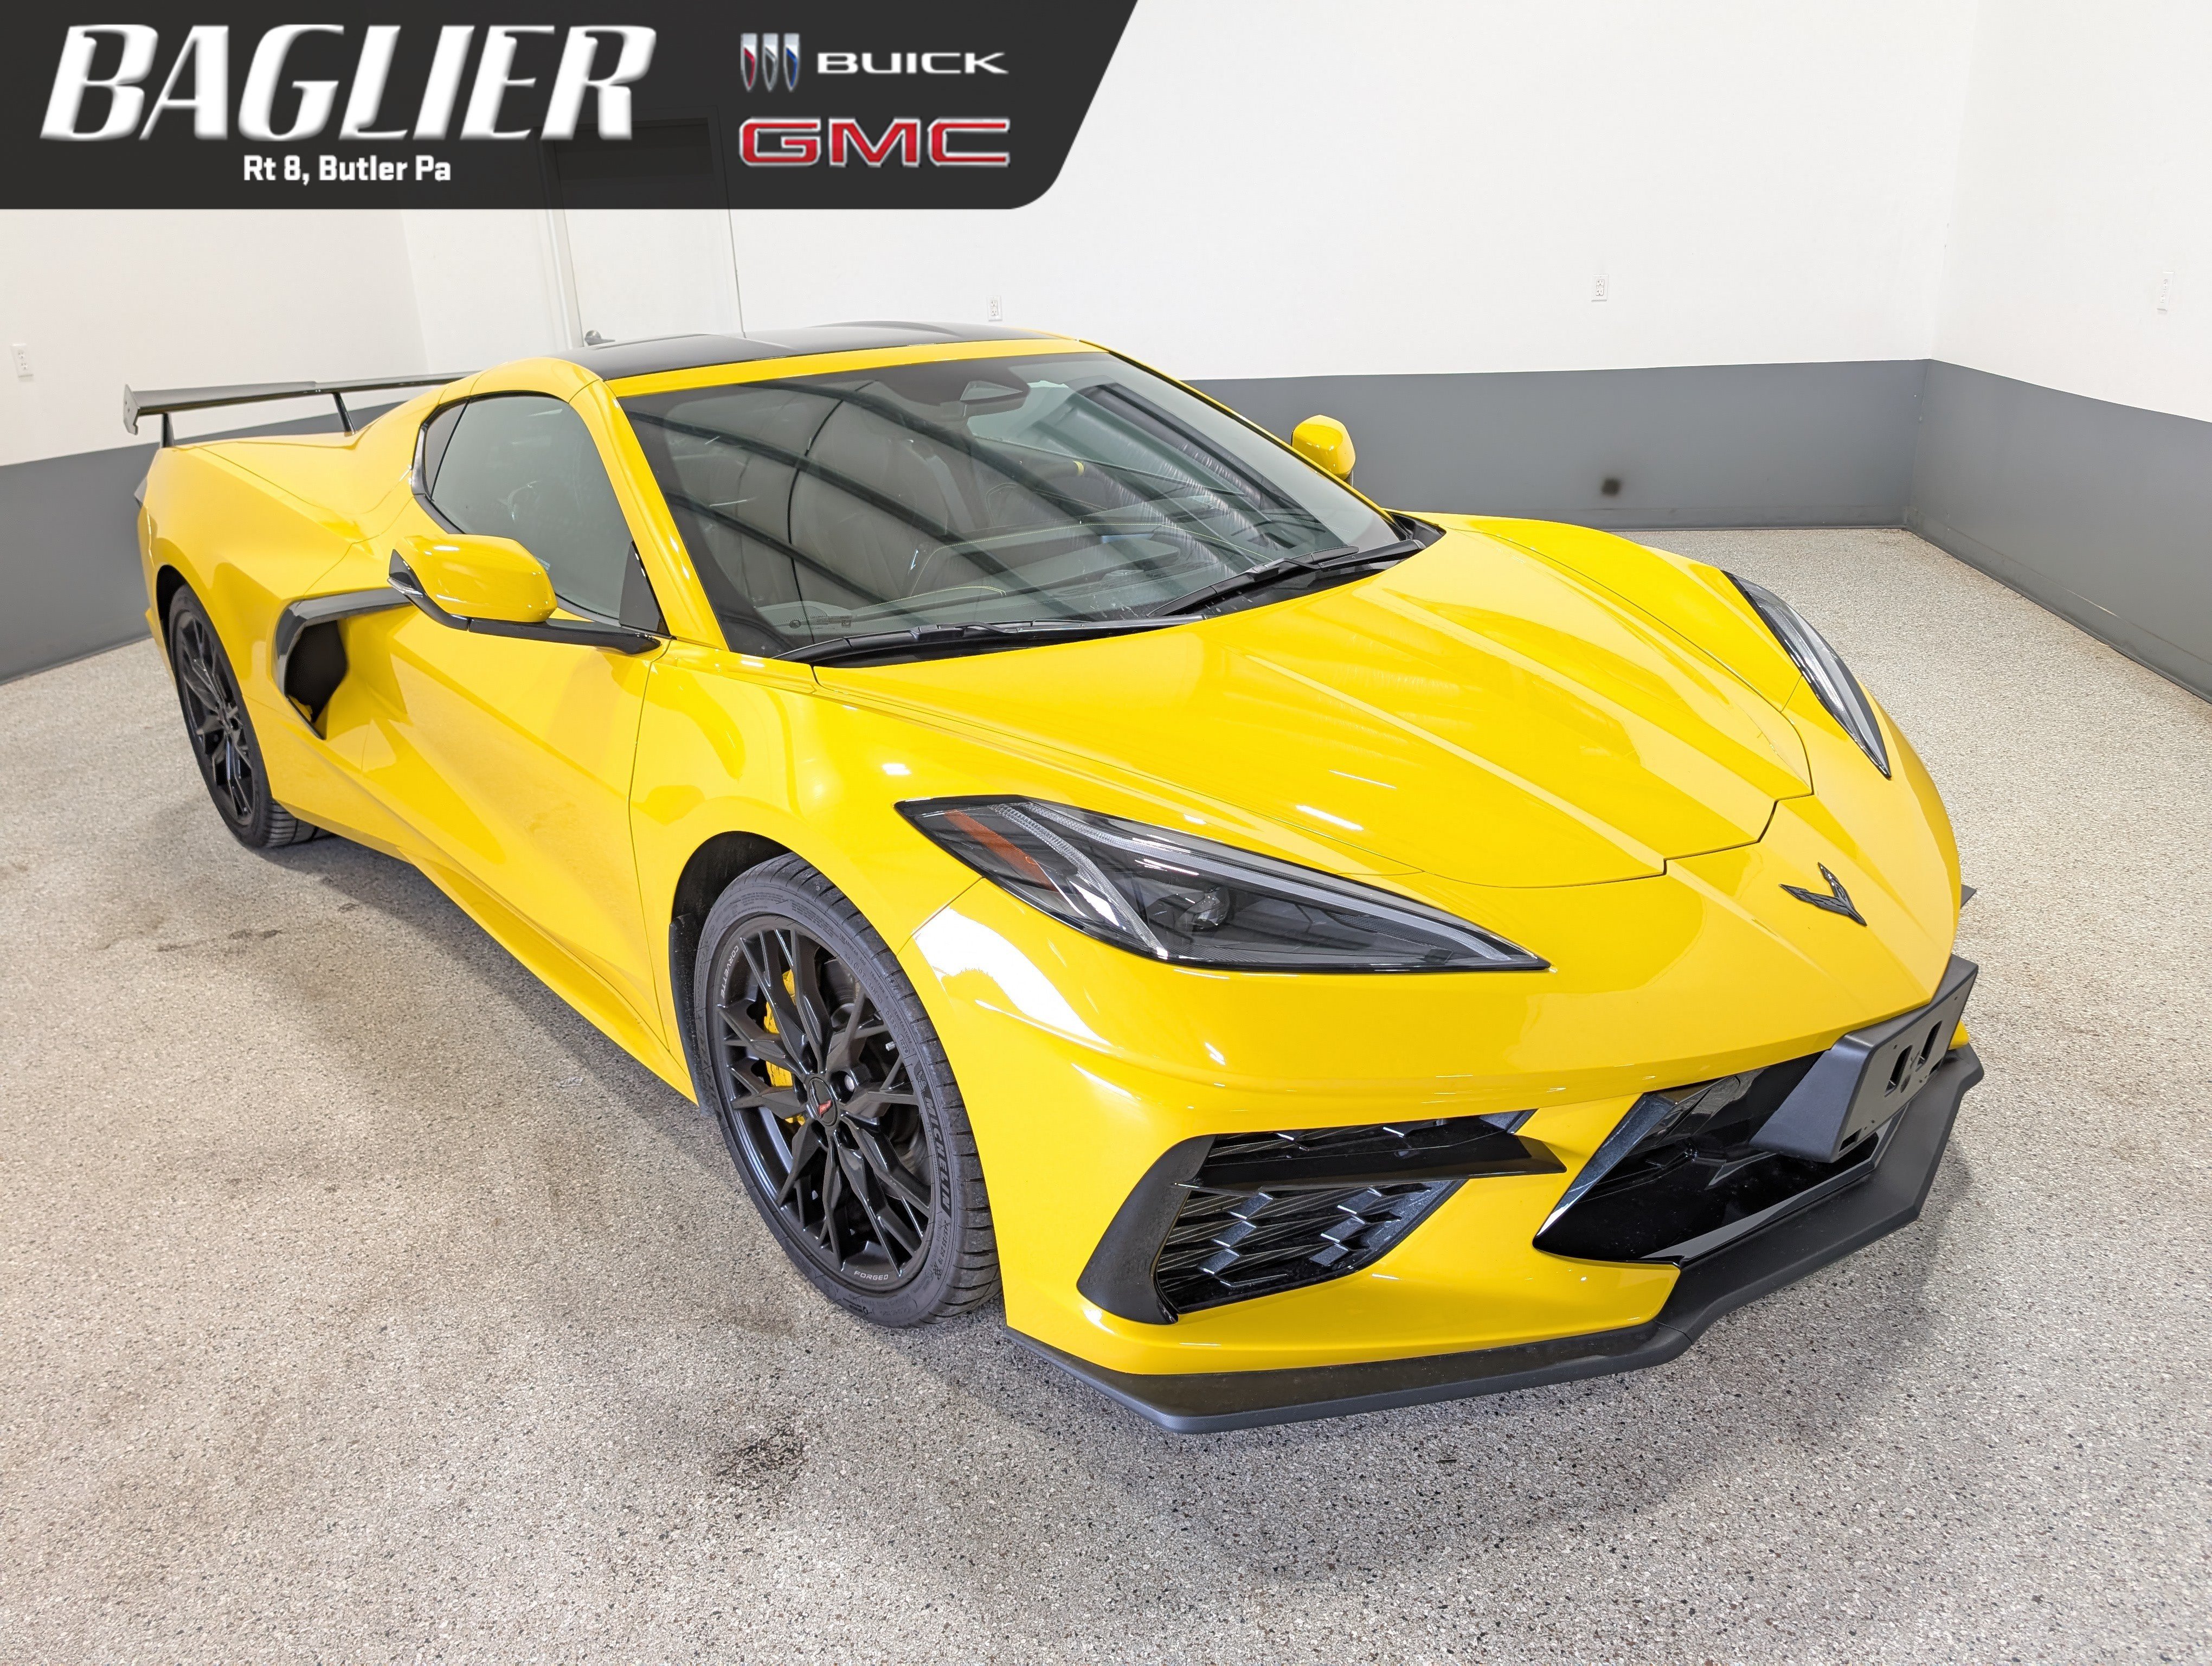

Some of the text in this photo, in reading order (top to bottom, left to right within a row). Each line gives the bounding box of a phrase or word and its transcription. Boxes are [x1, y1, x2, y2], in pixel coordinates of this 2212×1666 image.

[721, 945, 739, 999] CORVETTE
[870, 970, 885, 995] TRACTION
[893, 1007, 913, 1045] TEMPERATURE
[924, 1097, 950, 1210] MICHELIN
[854, 1270, 889, 1280] FORGED
